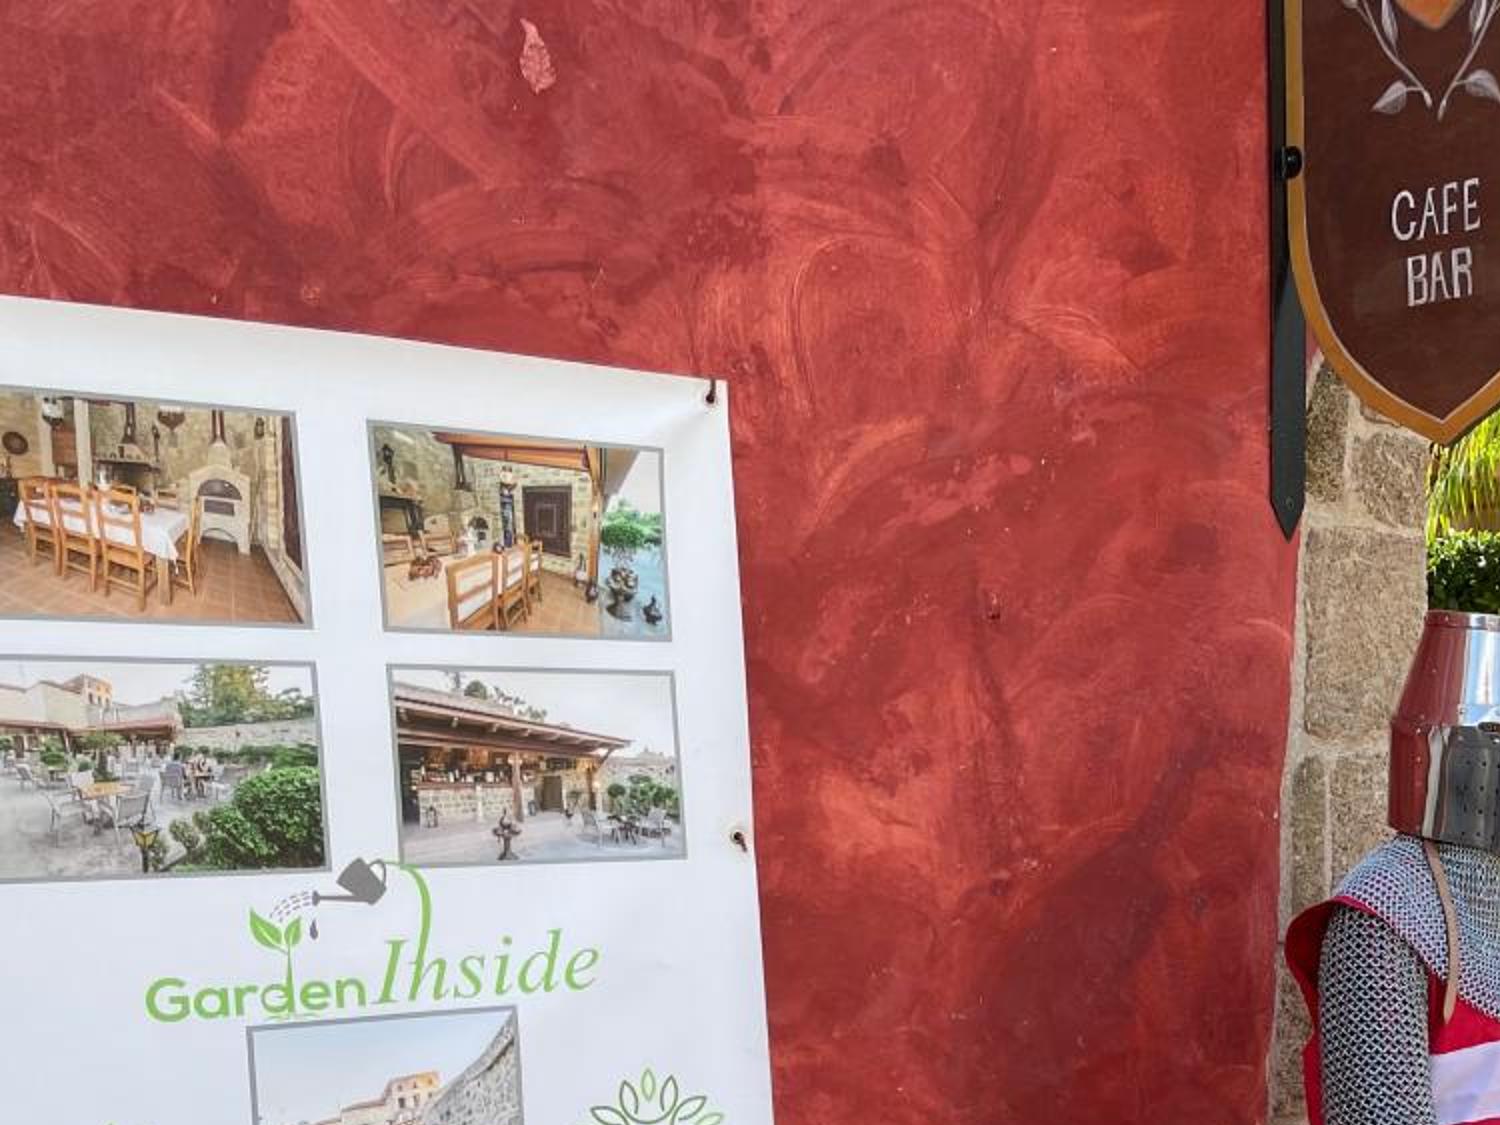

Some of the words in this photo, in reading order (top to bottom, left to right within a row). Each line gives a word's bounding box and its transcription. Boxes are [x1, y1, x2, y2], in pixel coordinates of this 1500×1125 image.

[1391, 177, 1481, 241] CAFE
[1407, 245, 1473, 306] BAR
[144, 955, 367, 1024] Garden
[371, 918, 603, 1006] Inside
